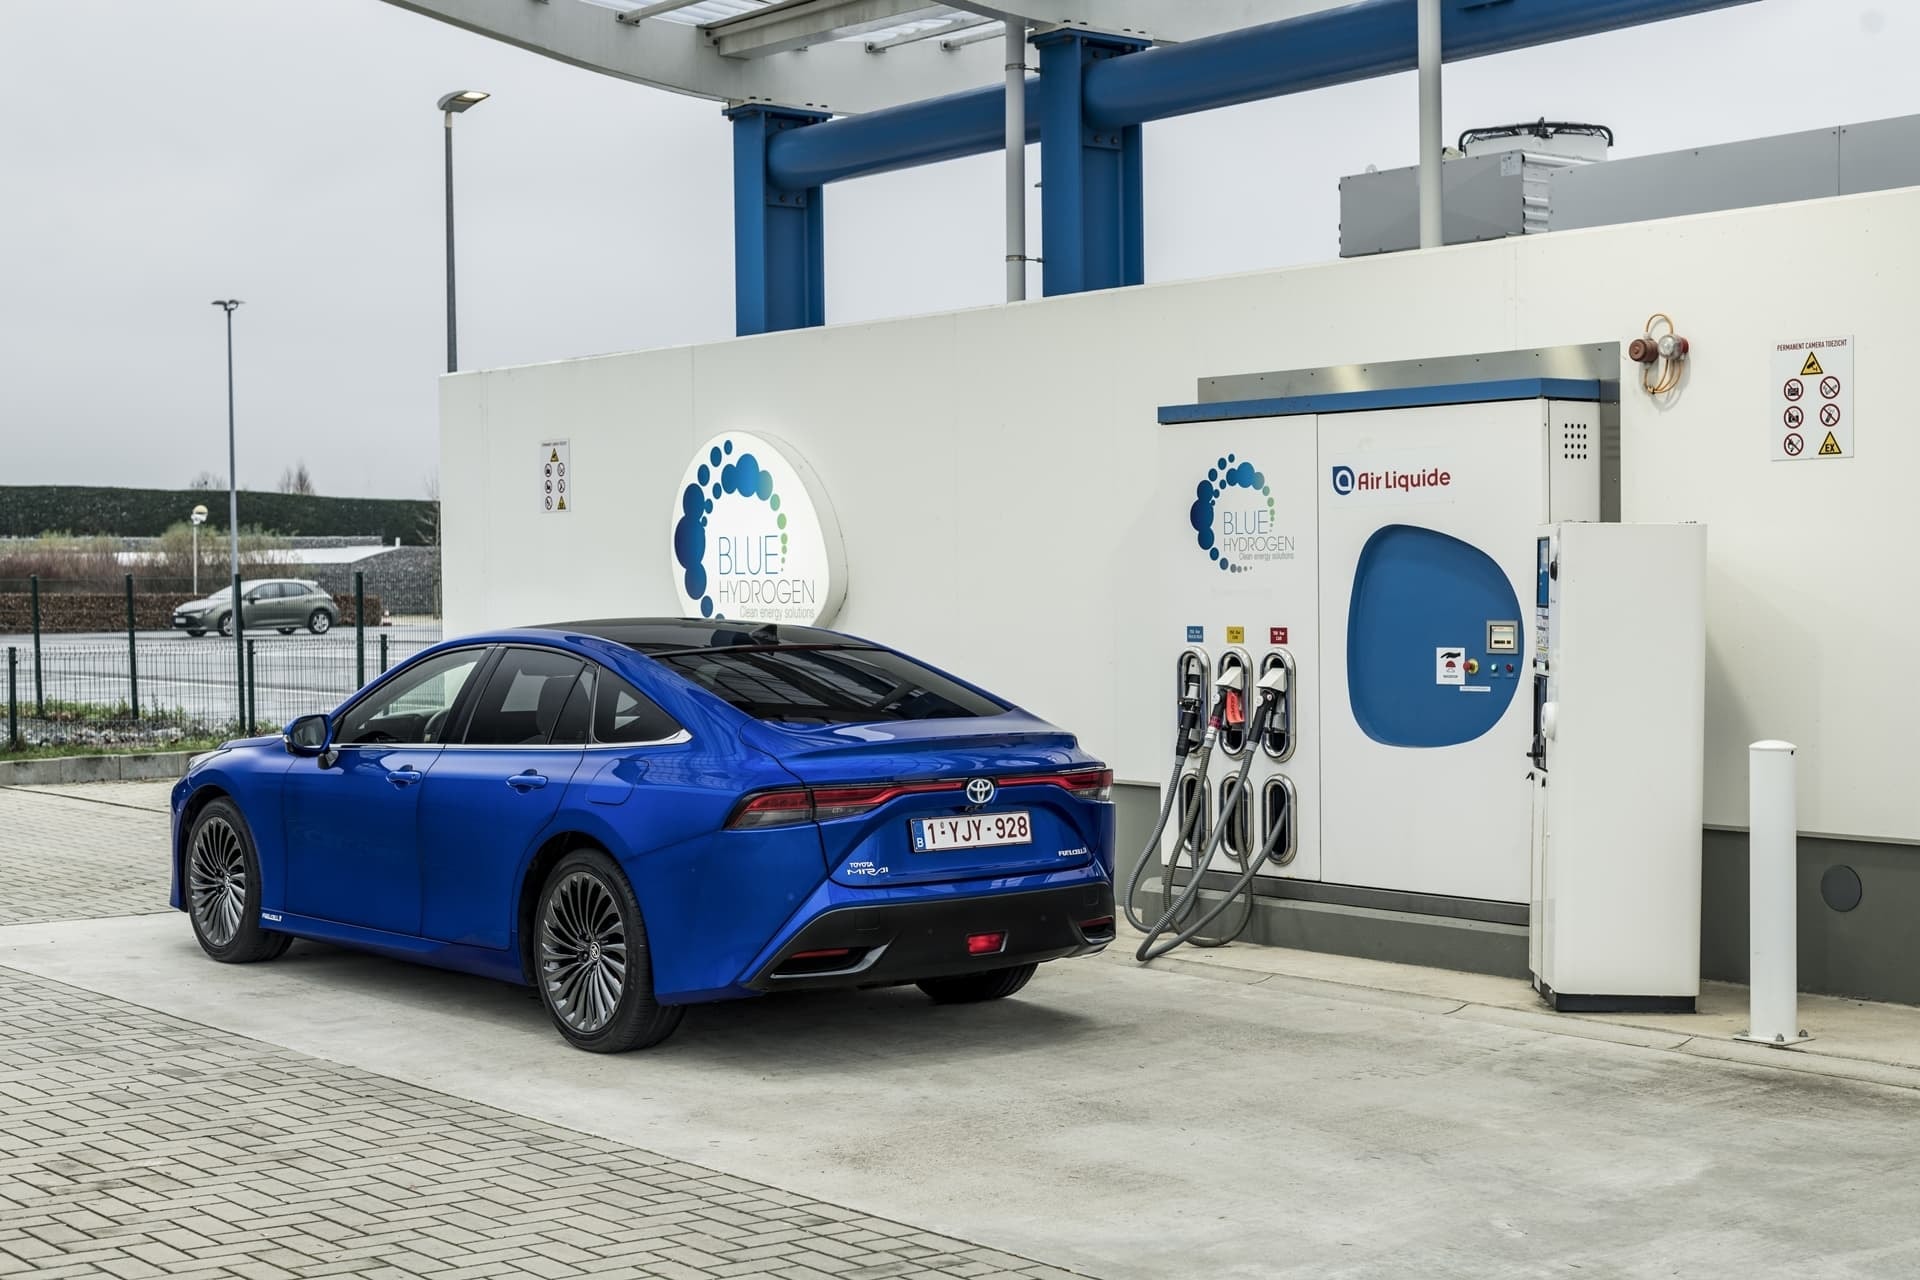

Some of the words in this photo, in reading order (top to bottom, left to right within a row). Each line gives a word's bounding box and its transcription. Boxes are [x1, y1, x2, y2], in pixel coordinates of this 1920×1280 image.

[1776, 342, 1804, 351] PERMANENT
[1805, 341, 1825, 349] CAMERA
[1825, 339, 1847, 348] TOEZICHT
[1825, 443, 1835, 452] EX
[1358, 472, 1382, 490] Air
[1385, 468, 1451, 492] Liquide
[1223, 510, 1268, 535] BLUE
[1223, 536, 1295, 552] HYDROGEN
[719, 535, 778, 575] BLUE
[719, 579, 815, 604] HYDROGEN
[740, 606, 758, 618] Clean
[760, 607, 782, 621] energy
[784, 605, 815, 618] solutions
[917, 838, 924, 848] B
[847, 866, 888, 876] MIRAI
